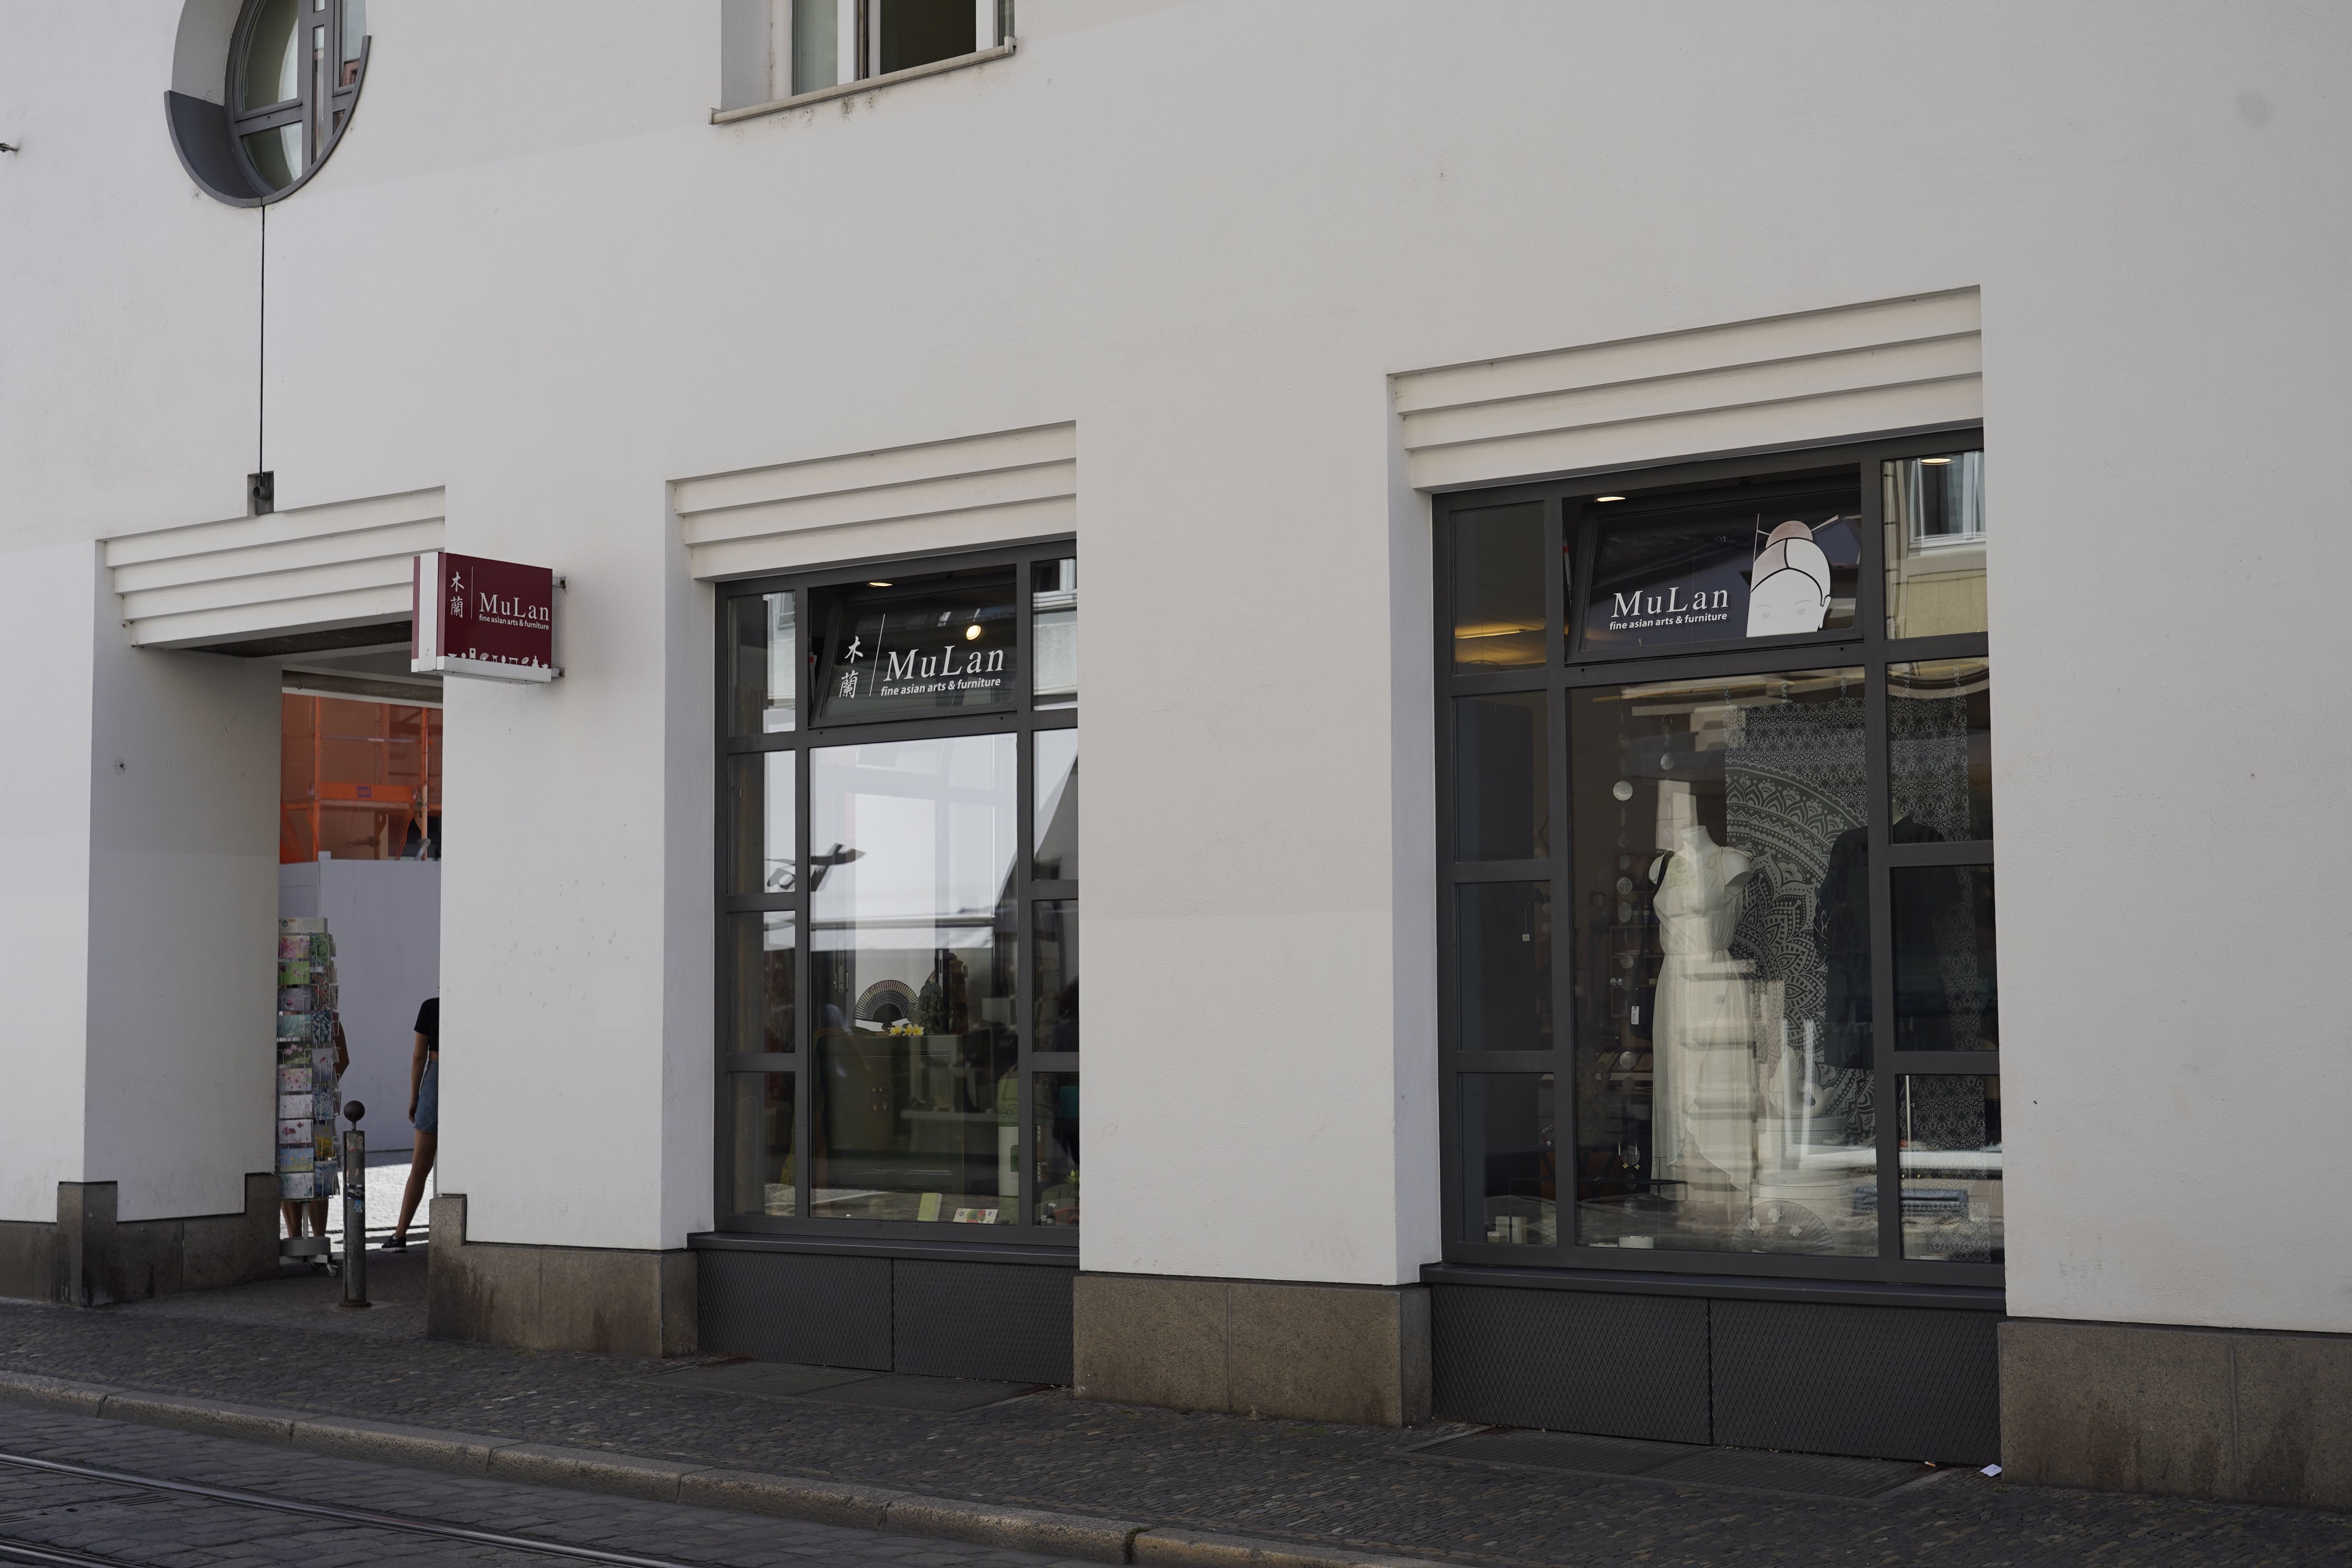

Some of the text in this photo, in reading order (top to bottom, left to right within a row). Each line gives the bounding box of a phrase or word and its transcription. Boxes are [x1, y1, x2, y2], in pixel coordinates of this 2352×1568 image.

[450, 571, 464, 618] 木蘭
[479, 592, 549, 621] MuLan
[1611, 587, 1728, 618] MuLan
[479, 614, 490, 622] fine
[524, 621, 549, 630] furniture
[1610, 613, 1727, 630] fine asian arts & furniture
[839, 636, 864, 699] 木蘭
[883, 645, 1004, 681] MuLan
[881, 677, 1001, 697] fine asian arts & furniture
